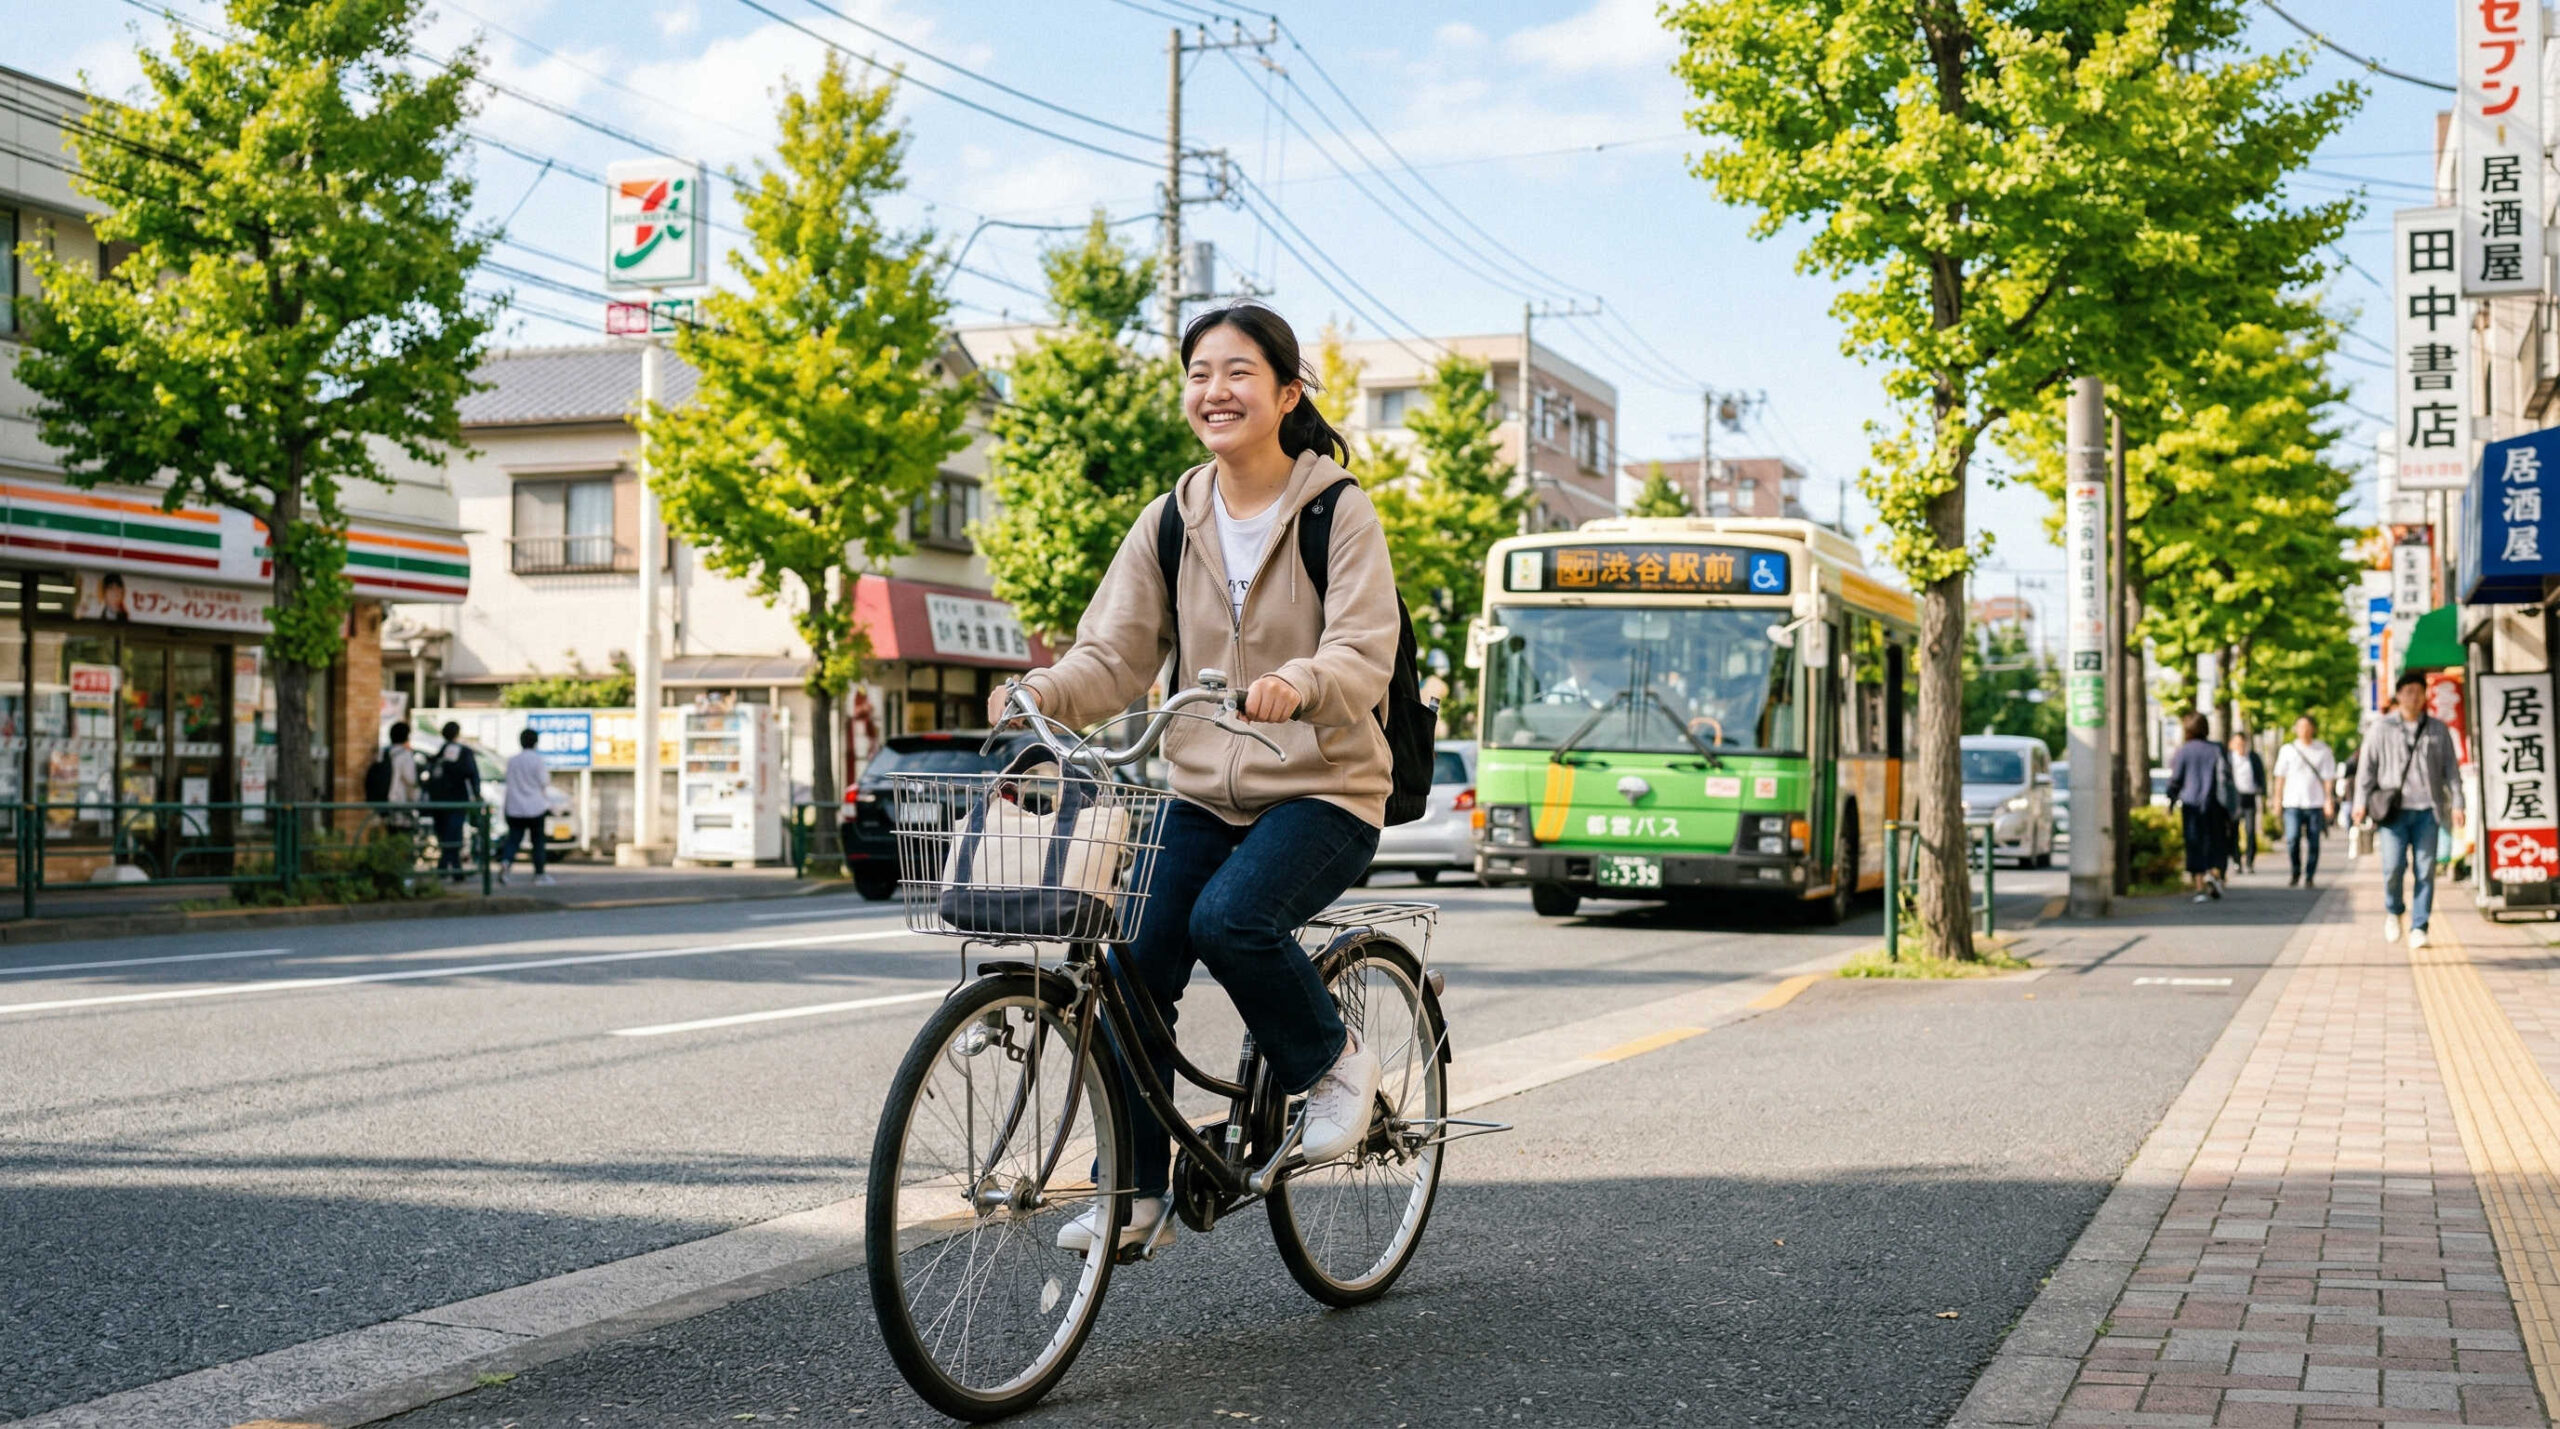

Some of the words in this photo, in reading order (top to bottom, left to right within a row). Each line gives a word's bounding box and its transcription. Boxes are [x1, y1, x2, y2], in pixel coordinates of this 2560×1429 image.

[2480, 155, 2523, 282] 居酒屋
[2407, 229, 2459, 449] 田中書店
[1601, 552, 1735, 583] 渋谷駅前
[2502, 446, 2542, 562] 居酒屋
[2497, 686, 2547, 820] 居酒屋
